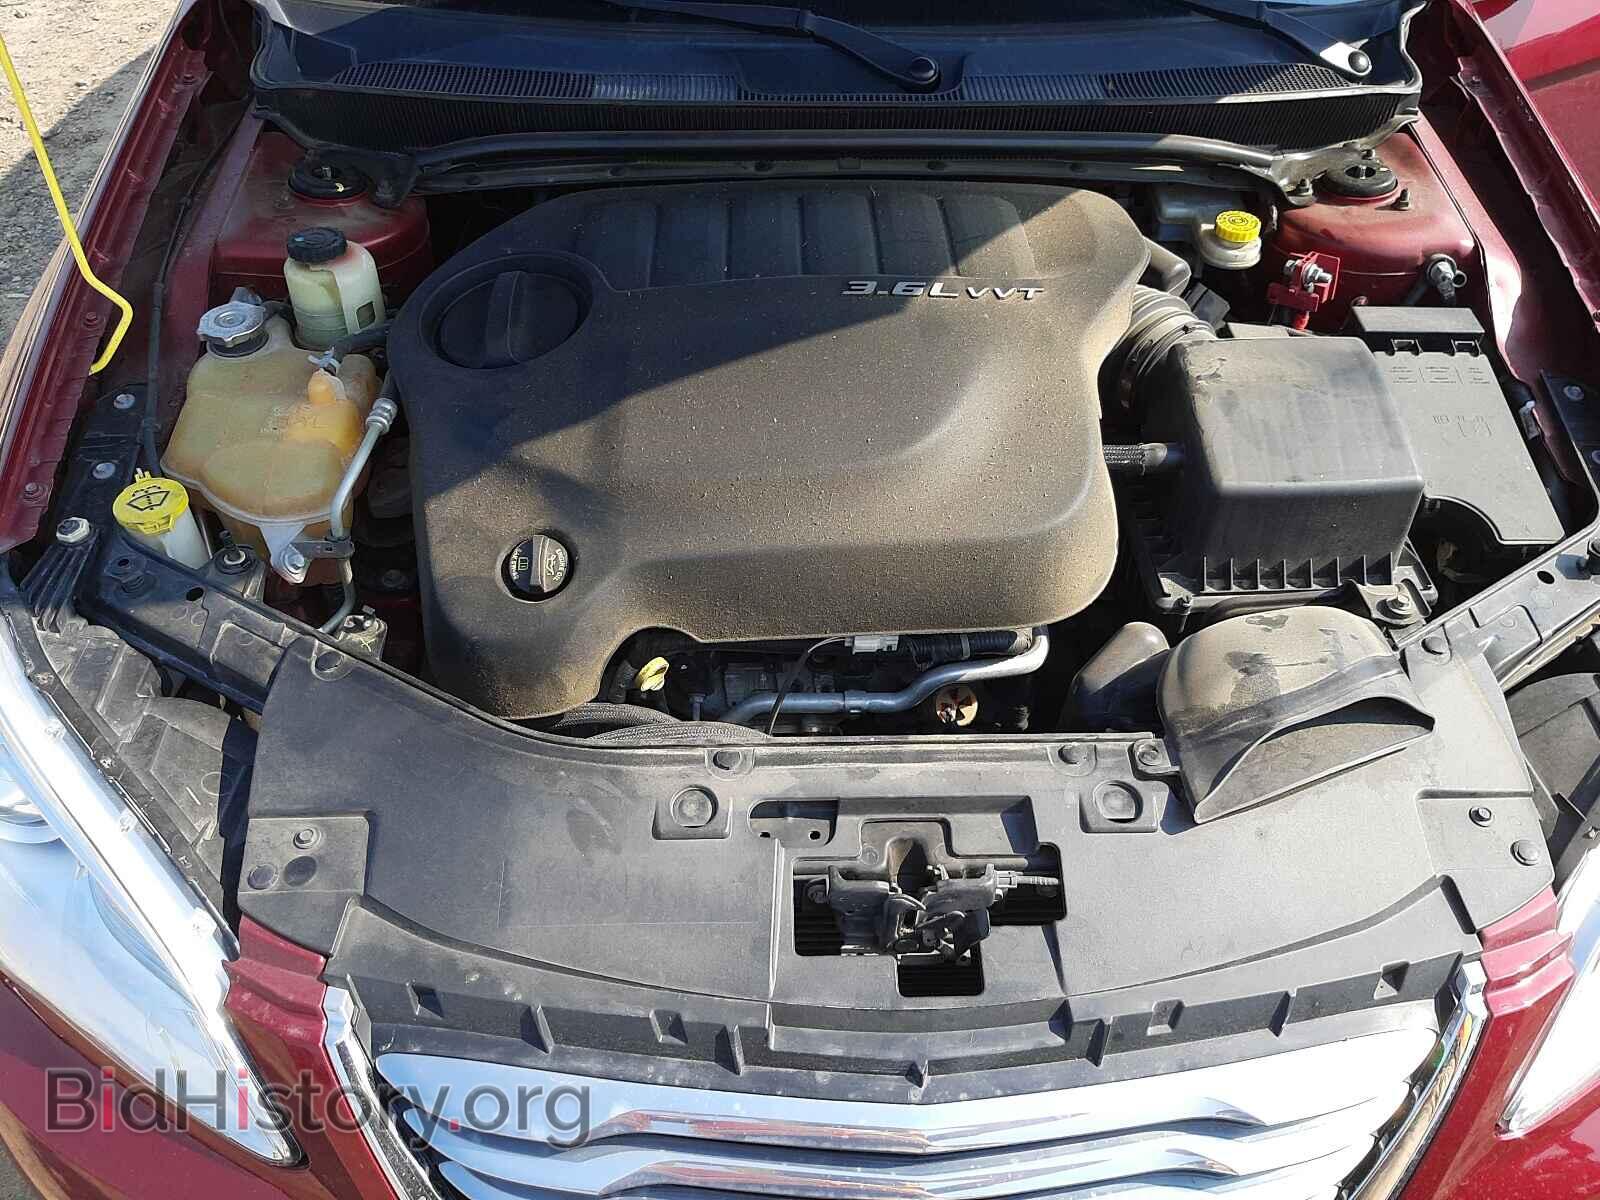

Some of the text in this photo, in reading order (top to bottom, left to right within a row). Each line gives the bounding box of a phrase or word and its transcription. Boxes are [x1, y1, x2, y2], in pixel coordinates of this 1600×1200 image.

[841, 280, 1046, 300] 3.6L VVT
[555, 548, 566, 571] ENGINE
